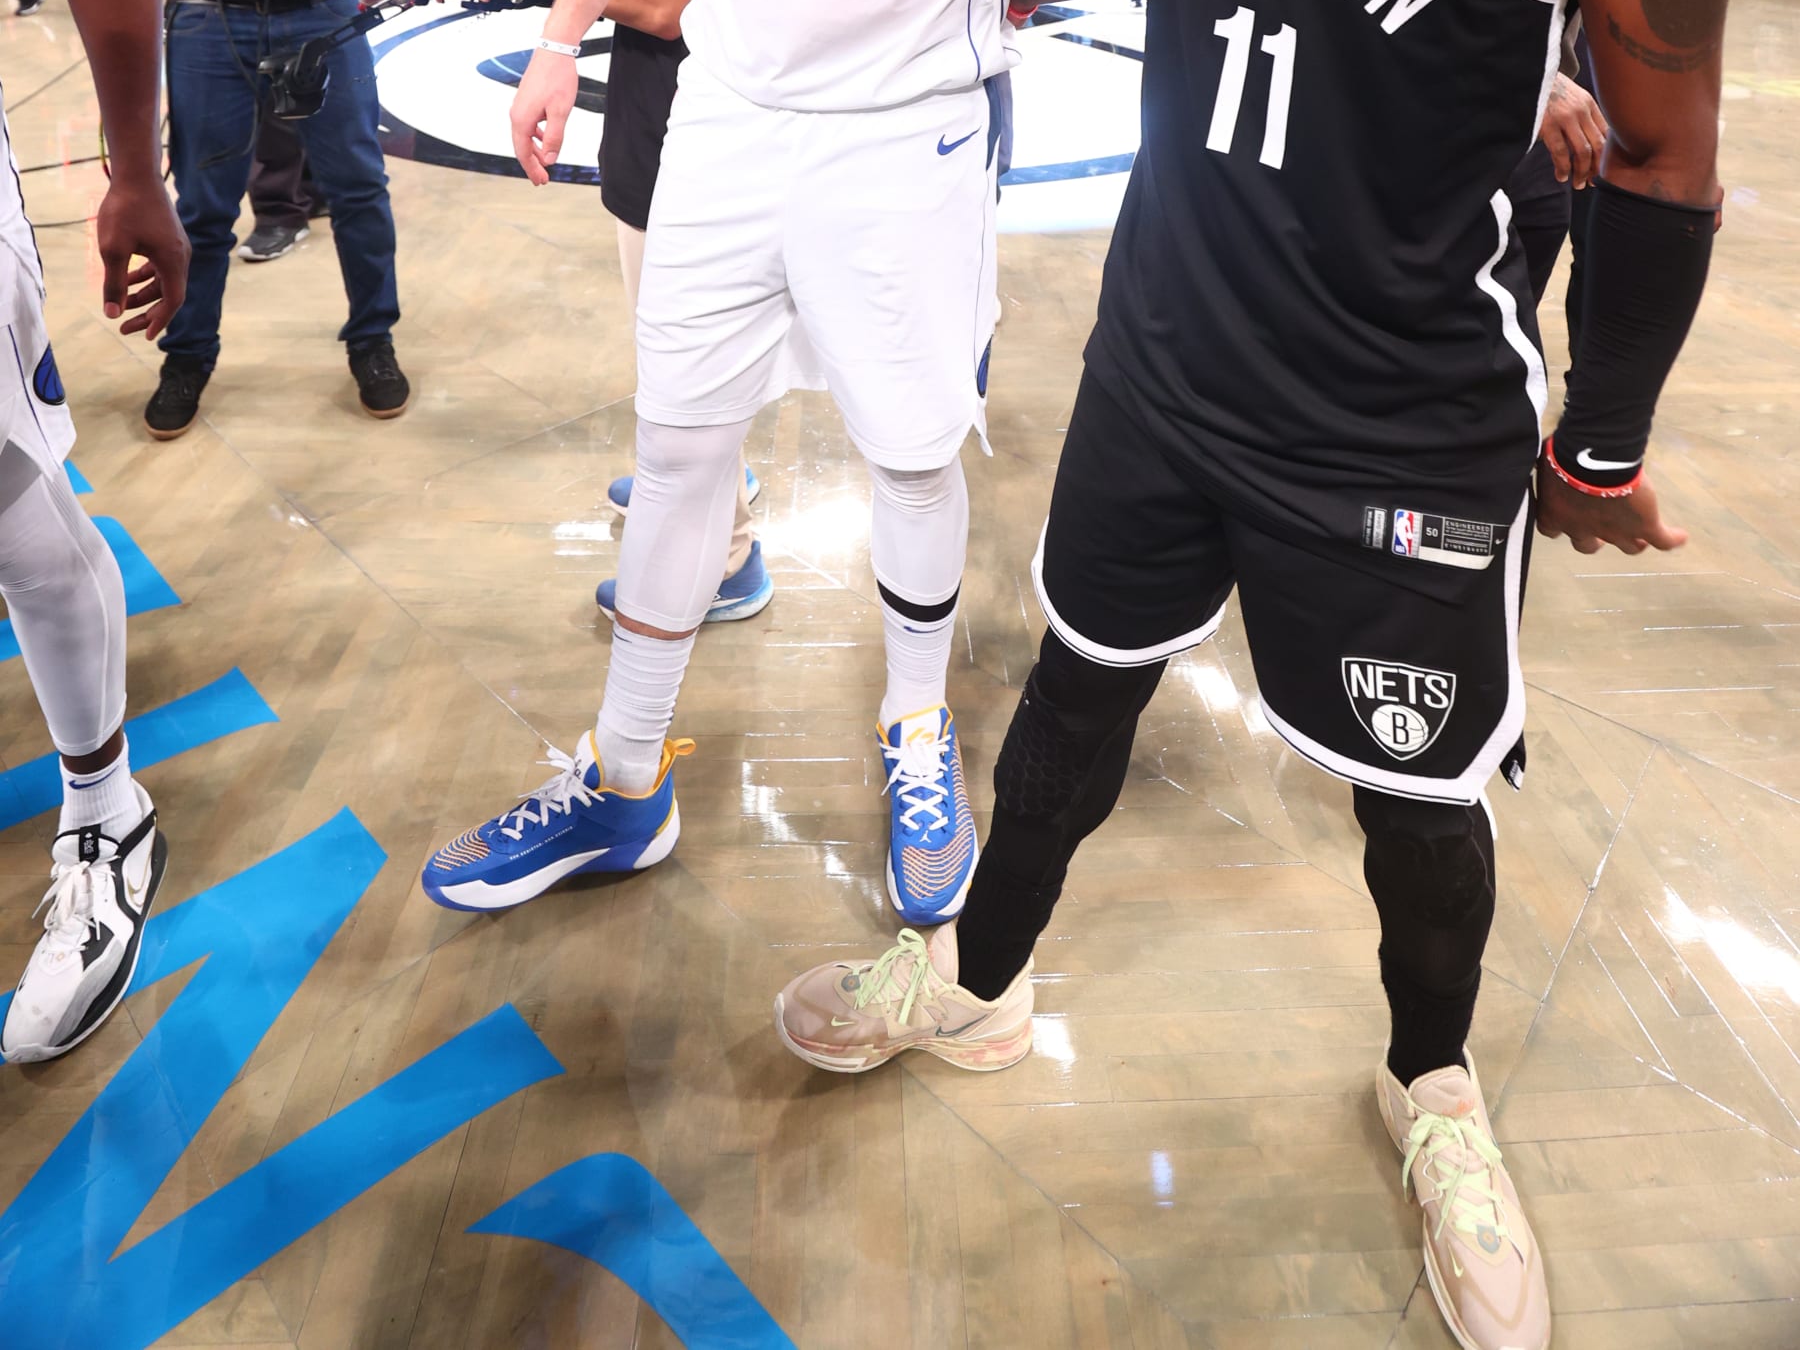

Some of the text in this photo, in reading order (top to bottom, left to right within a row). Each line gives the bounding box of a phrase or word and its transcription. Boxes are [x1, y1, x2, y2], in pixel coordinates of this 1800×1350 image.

[1204, 4, 1298, 170] 11
[1425, 526, 1439, 538] 50
[1350, 662, 1450, 710] NETS
[1391, 711, 1410, 746] B
